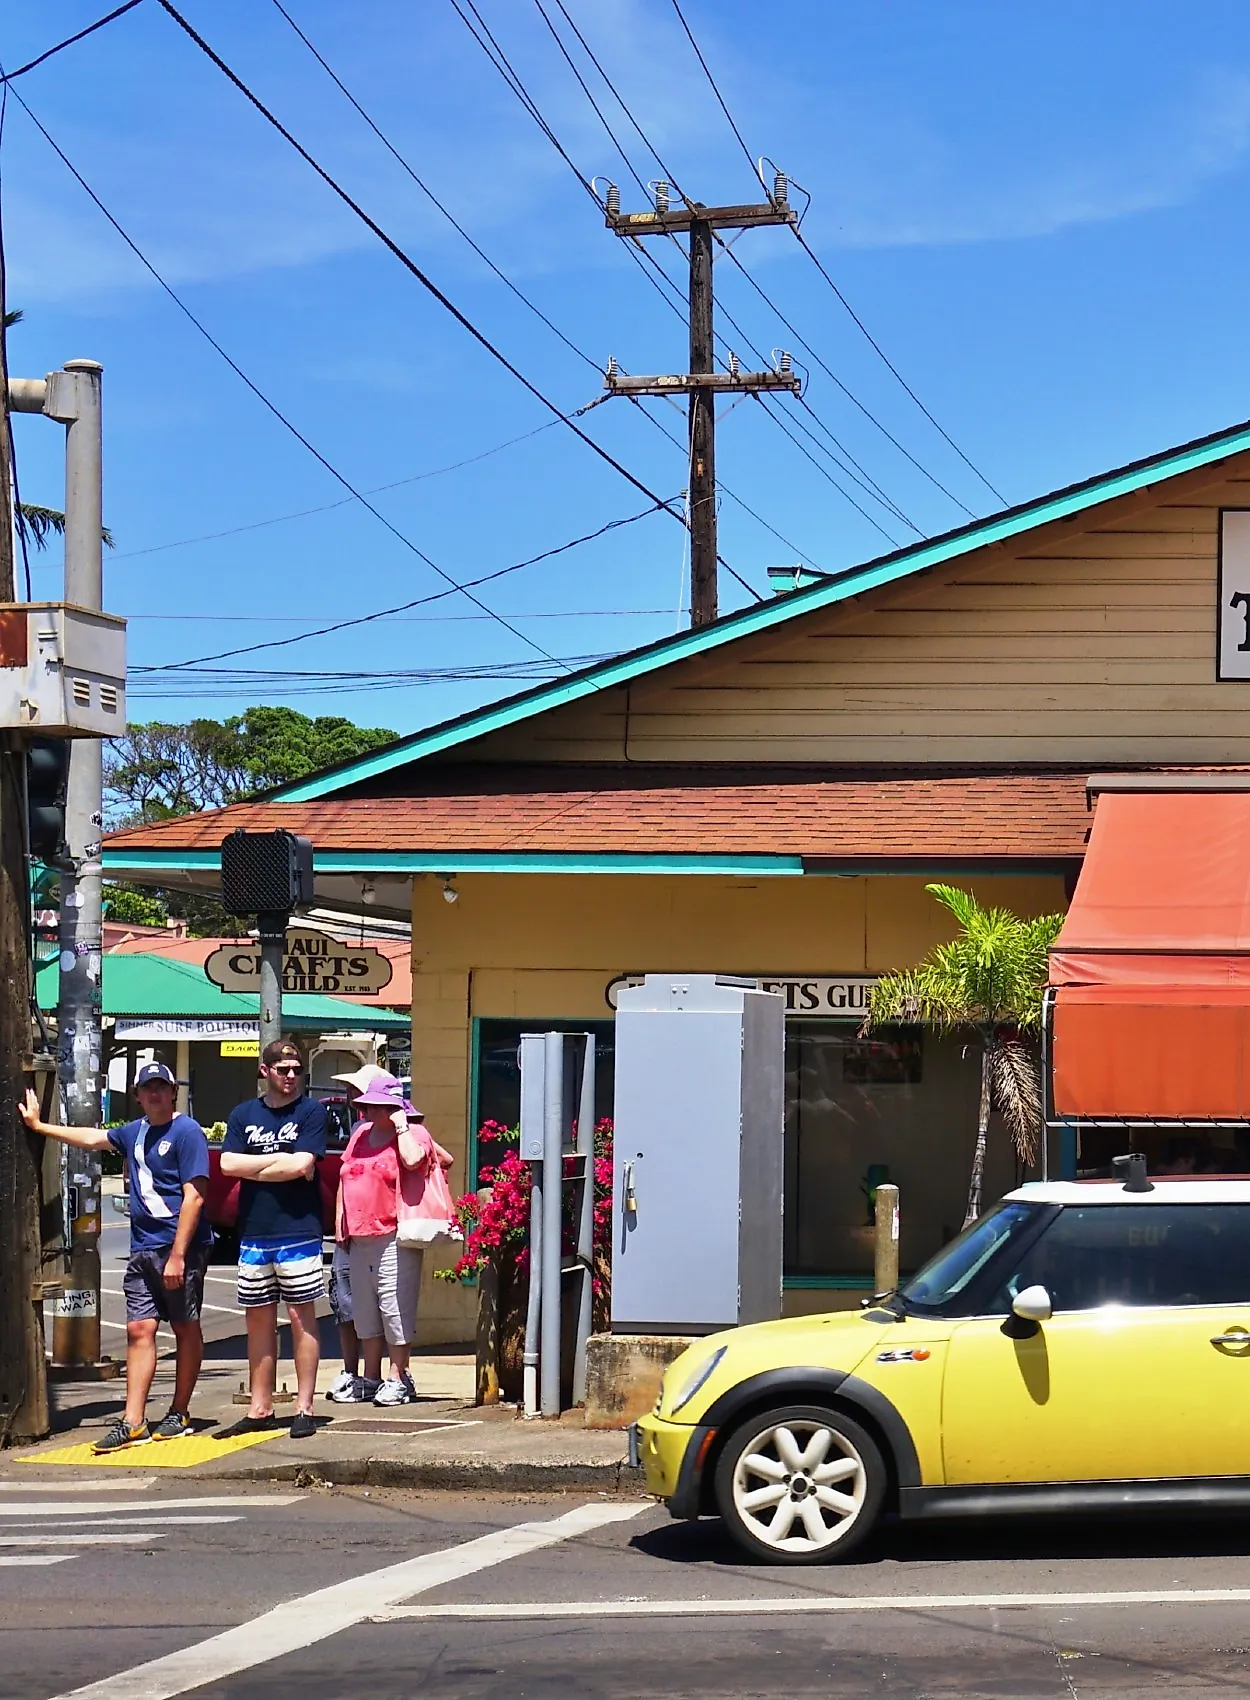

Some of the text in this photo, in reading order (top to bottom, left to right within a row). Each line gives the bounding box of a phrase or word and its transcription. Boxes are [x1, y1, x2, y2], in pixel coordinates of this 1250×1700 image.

[283, 938, 329, 957] AUI
[228, 953, 370, 977] CAFTS
[282, 975, 340, 992] UILD
[156, 1021, 193, 1033] SURF
[197, 1021, 260, 1035] BOUTIQU
